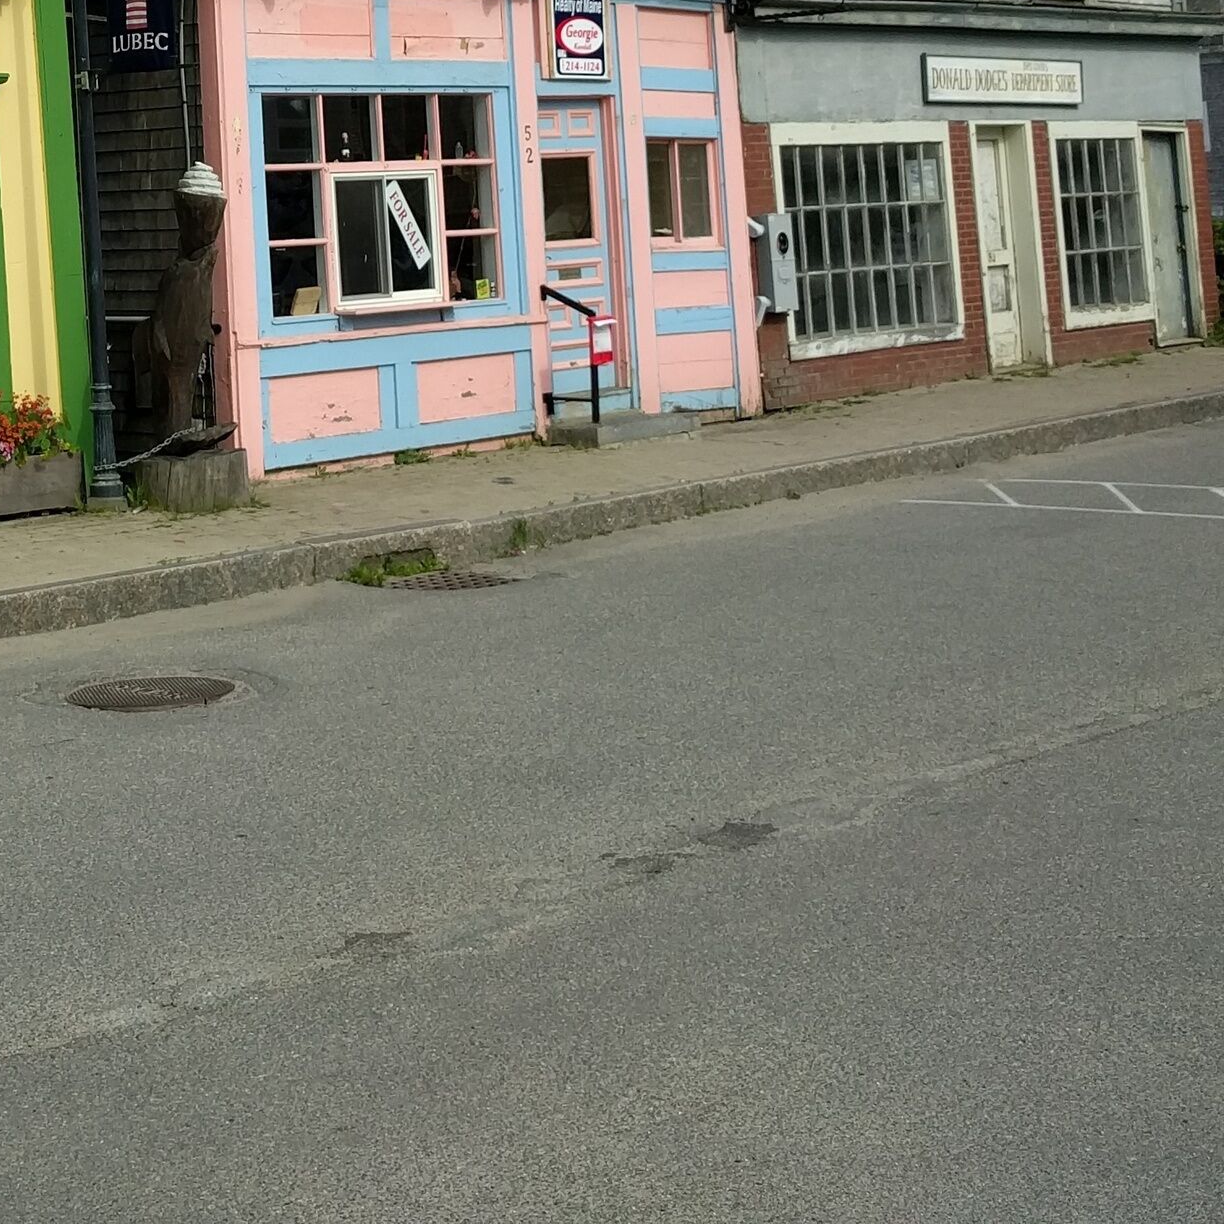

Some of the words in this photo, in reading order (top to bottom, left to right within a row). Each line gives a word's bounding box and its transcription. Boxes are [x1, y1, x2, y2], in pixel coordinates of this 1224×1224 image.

[112, 32, 169, 54] LUBEC
[566, 24, 598, 43] Georgie
[931, 67, 971, 90] DONALD
[1011, 72, 1053, 92] DEPARTMENT
[1056, 74, 1078, 93] STORE
[389, 191, 408, 223] FOR
[403, 221, 426, 259] SALE
